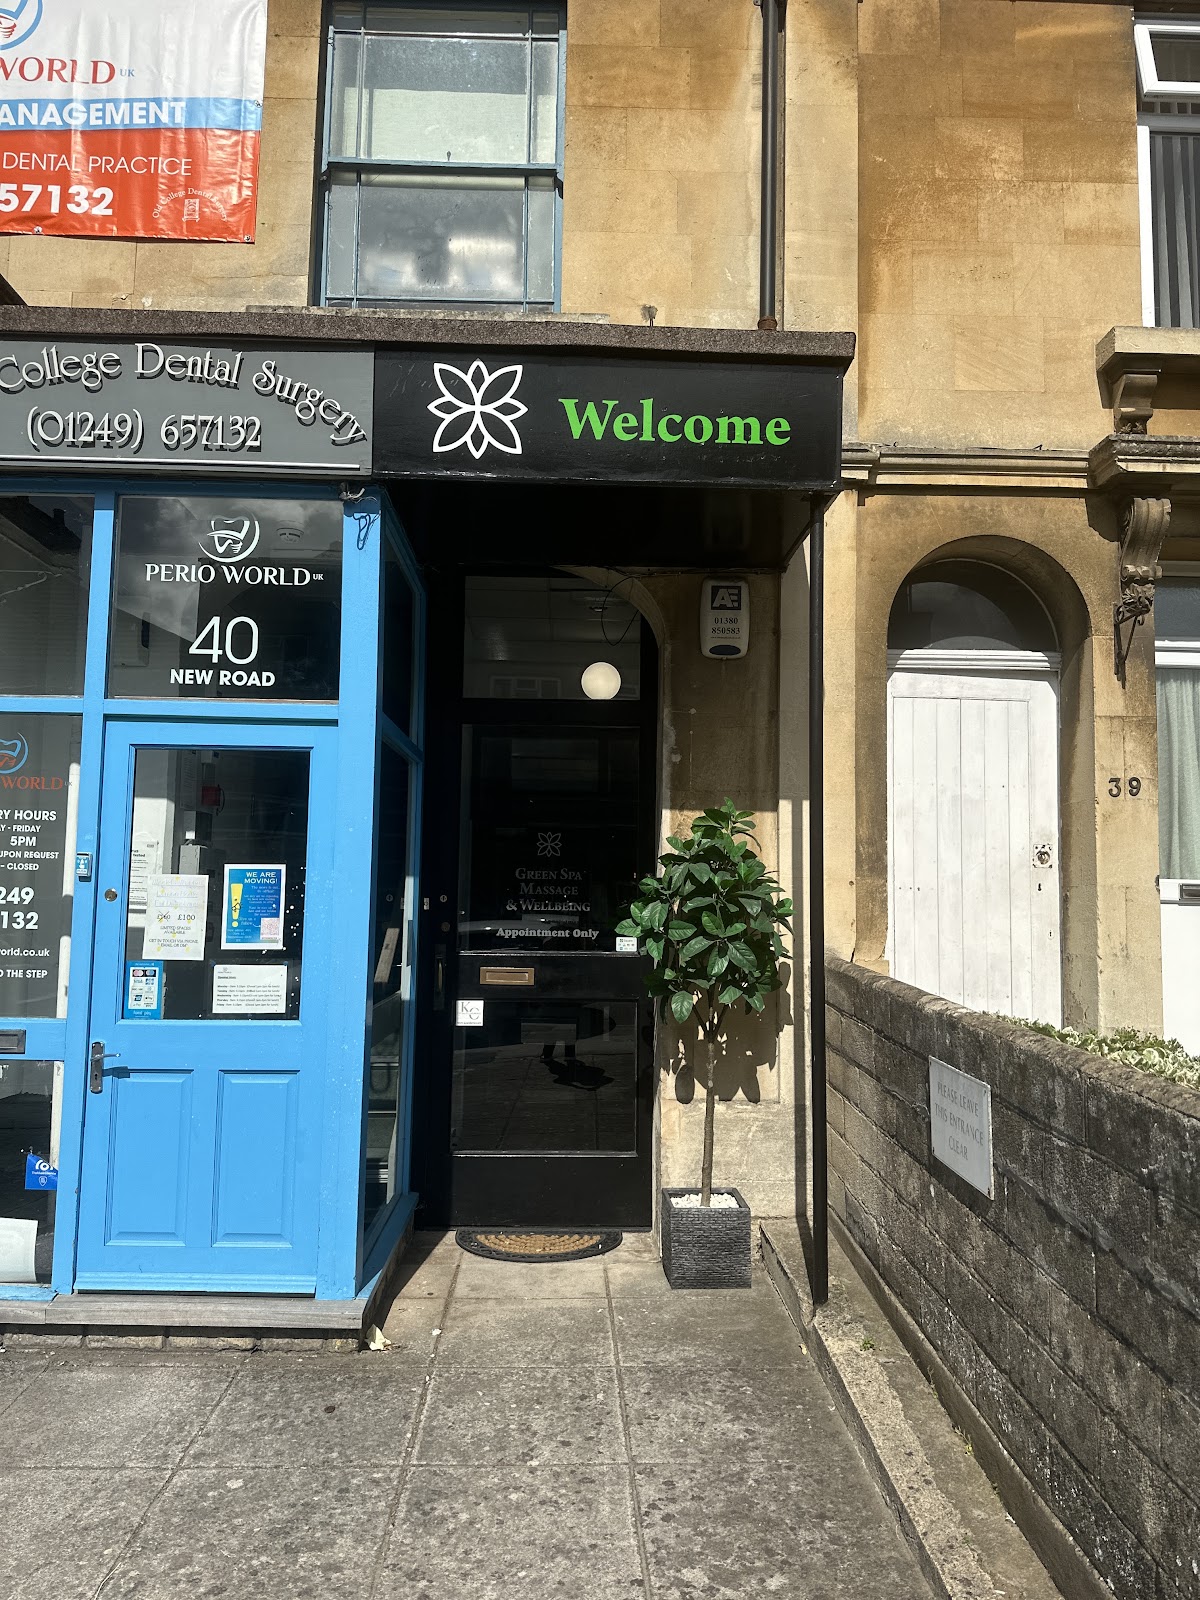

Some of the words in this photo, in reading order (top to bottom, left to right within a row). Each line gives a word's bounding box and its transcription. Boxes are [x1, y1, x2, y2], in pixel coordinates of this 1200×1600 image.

[120, 69, 135, 77] UK
[2, 152, 82, 171] DENTAL
[88, 156, 192, 176] PRACTICE
[0, 183, 114, 216] 57132
[152, 204, 163, 218] Old
[160, 190, 186, 204] College
[187, 187, 213, 201] Dental
[0, 345, 121, 389] College
[135, 342, 243, 387] Dental
[252, 360, 366, 443] Surgery
[27, 406, 145, 450] (01249)
[160, 414, 261, 449] 657132
[558, 398, 791, 446] Welcome
[145, 563, 215, 583] PERIO
[220, 565, 311, 586] WORLD
[312, 573, 324, 581] UK
[714, 617, 739, 625] 01380
[711, 627, 740, 635] 850583
[188, 616, 259, 665] 40
[170, 669, 214, 685] NEW
[219, 670, 276, 687] ROAD
[1, 776, 64, 790] WORLD
[1108, 776, 1142, 798] 39
[14, 810, 57, 821] HOURS
[12, 824, 41, 833] FRIDAY
[10, 835, 37, 847] 5PM
[23, 851, 60, 859] REQUEST
[6, 862, 40, 871] CLOSED
[505, 899, 518, 911] &
[0, 910, 39, 930] 132
[496, 927, 570, 939] Appointment
[572, 928, 600, 940] Only
[0, 947, 50, 957] orld.co.uk
[6, 969, 24, 978] THE
[26, 969, 48, 979] STEP
[937, 1081, 958, 1105] PLEASE
[959, 1094, 979, 1118] LEAVE
[934, 1102, 948, 1122] THIS
[949, 1112, 984, 1147] ENTRANCE
[948, 1135, 968, 1161] CLEAR
